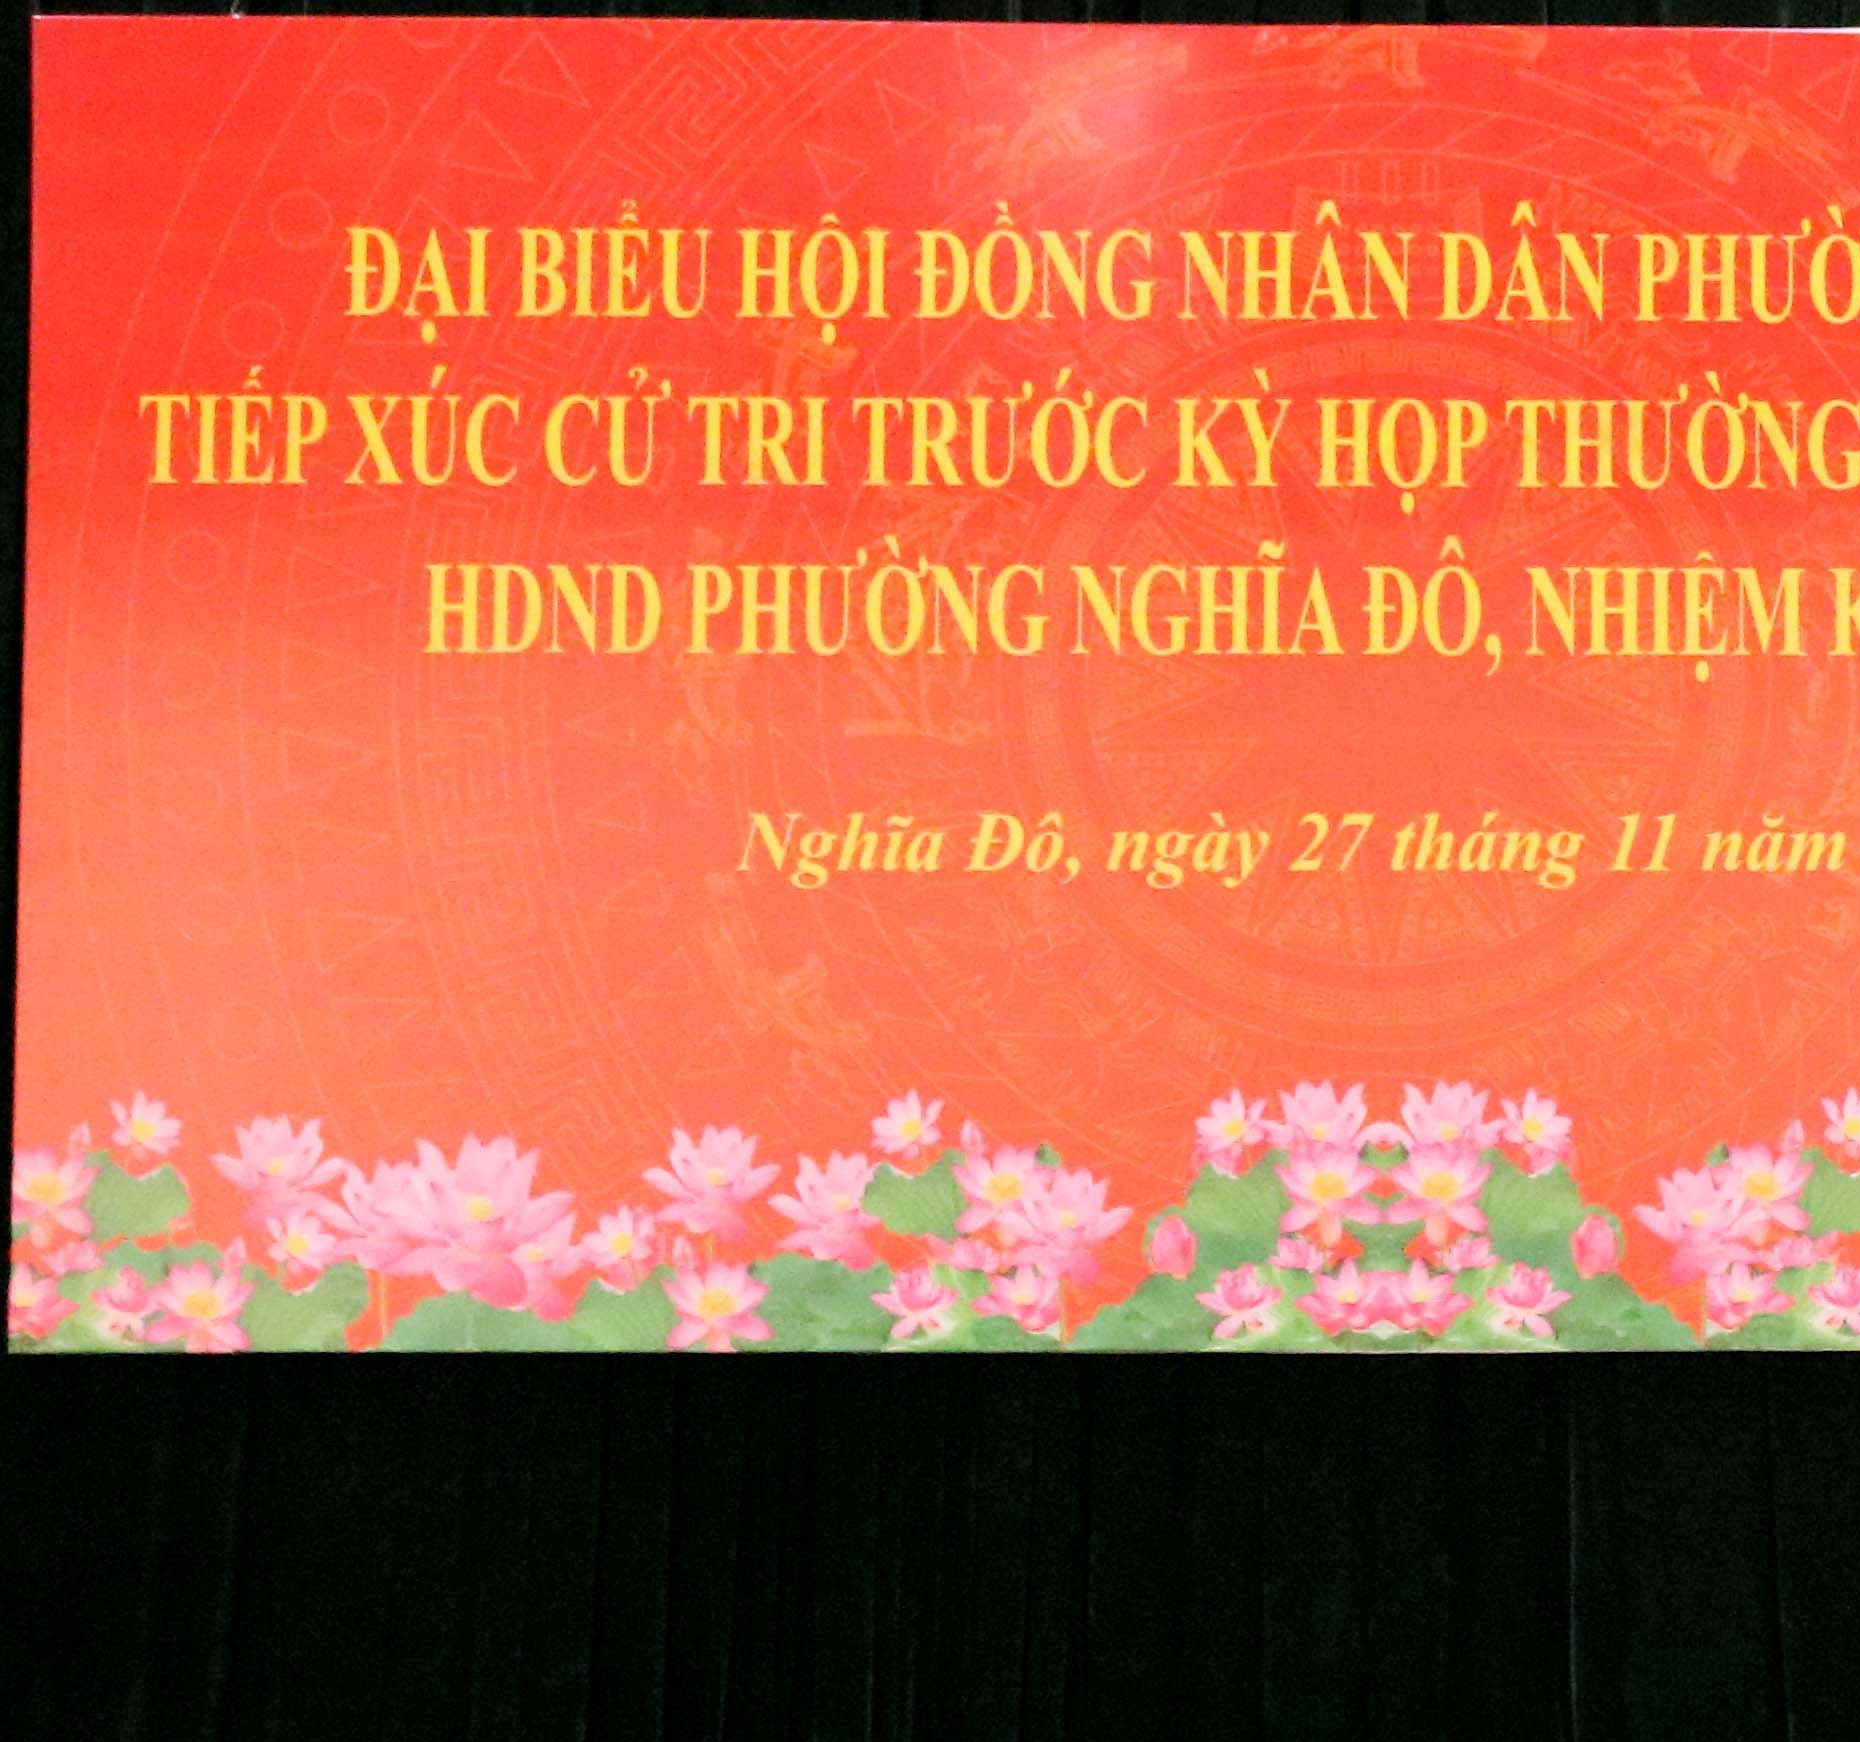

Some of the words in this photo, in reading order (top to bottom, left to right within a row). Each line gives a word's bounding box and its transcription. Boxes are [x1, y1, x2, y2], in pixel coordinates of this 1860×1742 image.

[345, 227, 490, 343] ĐẠI
[518, 199, 710, 319] BIỂU
[737, 213, 889, 345] HỘI
[914, 201, 1155, 321] ĐỒNG
[1179, 200, 1414, 320] NHÂN
[1439, 201, 1609, 321] DÂN
[140, 366, 327, 485] TIẾP
[345, 365, 520, 487] XÚC
[545, 367, 672, 488] CỬ
[688, 395, 827, 485] TRI
[852, 367, 1148, 488] TRƯỚC
[1173, 368, 1292, 487] KỲ
[1316, 398, 1488, 514] HỌP
[424, 564, 662, 654] HDND
[687, 535, 1048, 656] PHƯỜNG
[1071, 540, 1344, 656] NGHĨA
[1363, 535, 1502, 673] ĐÔ,
[1526, 551, 1807, 682] NHIỆM
[737, 812, 944, 889] Nghĩa
[968, 812, 1081, 877] Đô,
[1107, 812, 1269, 888] ngày
[1289, 812, 1373, 872] 27
[1391, 812, 1584, 889] tháng
[1610, 813, 1675, 872] 11
[1702, 813, 1846, 872] năm
